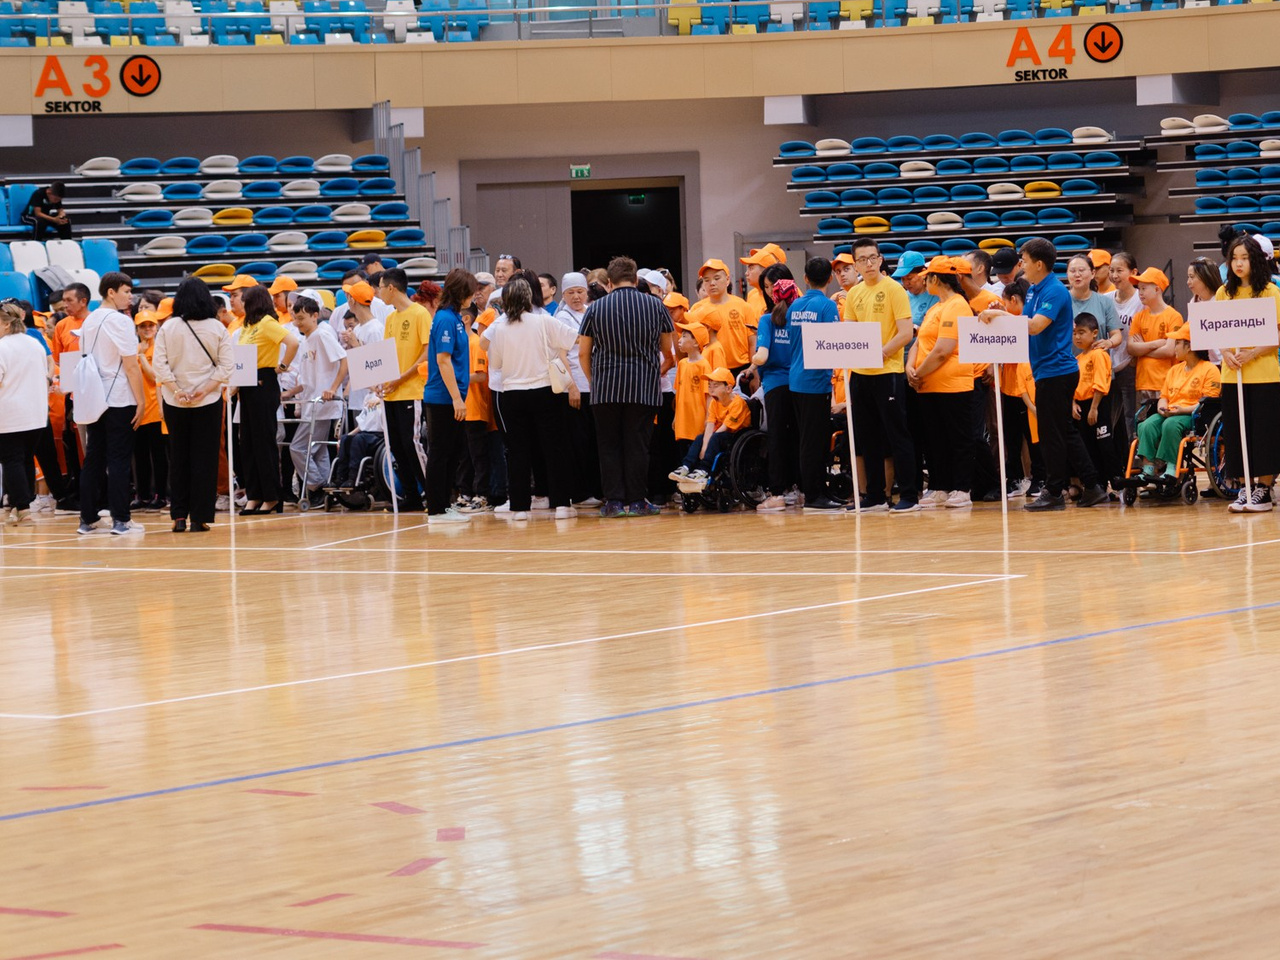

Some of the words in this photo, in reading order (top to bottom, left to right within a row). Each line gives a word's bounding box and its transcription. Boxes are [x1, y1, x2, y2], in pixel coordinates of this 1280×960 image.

[1014, 67, 1069, 82] SEKTOR
[44, 100, 103, 113] SEKTOR
[1200, 317, 1267, 332] Қарағанды
[815, 340, 869, 352] Жаңаөзен
[969, 333, 1017, 346] Жаңаарқа
[364, 357, 383, 371] Арал
